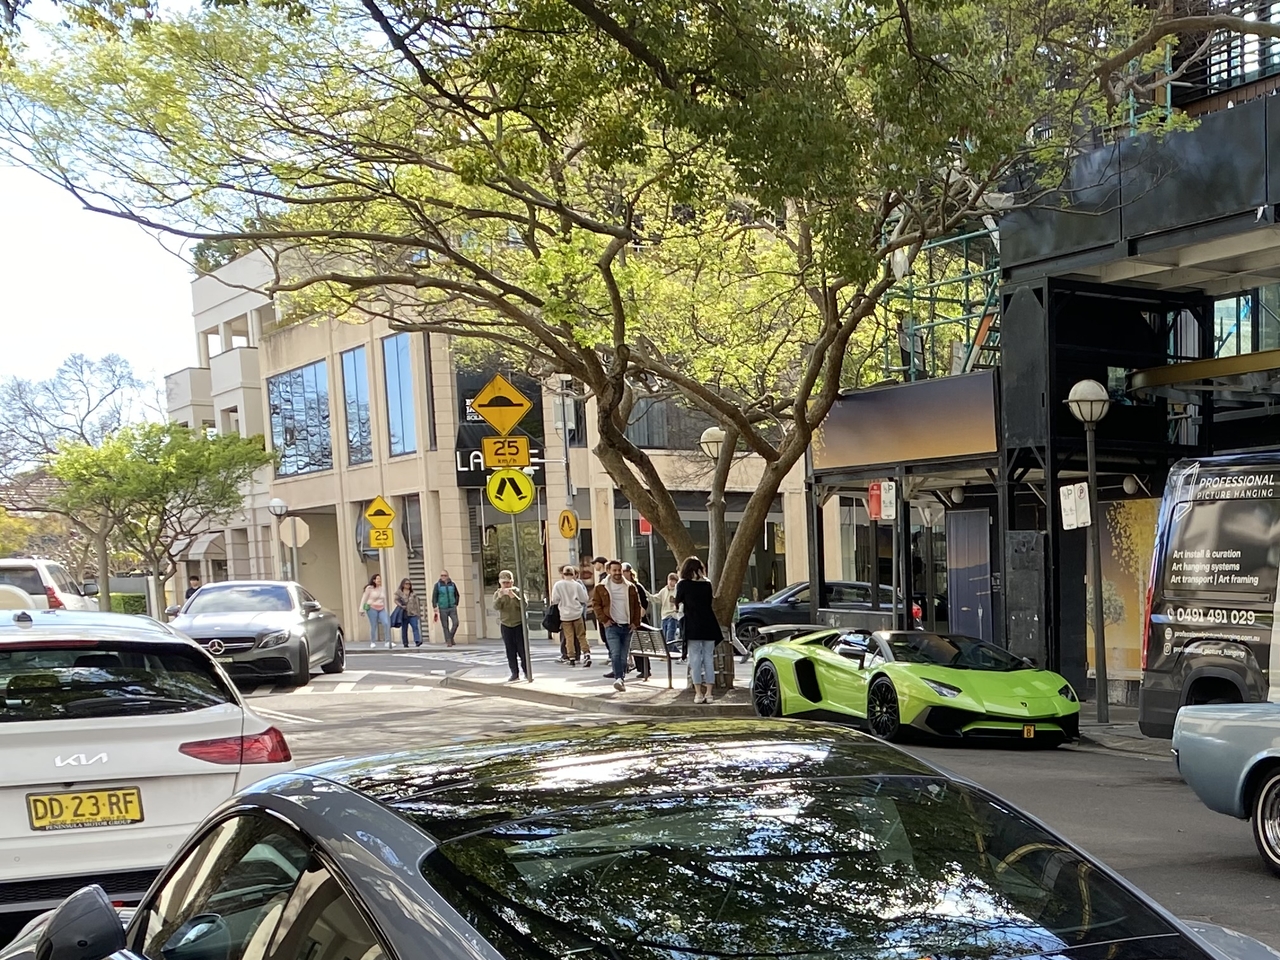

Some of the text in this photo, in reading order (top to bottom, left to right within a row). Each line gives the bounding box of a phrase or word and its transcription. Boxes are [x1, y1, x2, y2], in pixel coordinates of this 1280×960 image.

[493, 440, 520, 457] 25
[1199, 474, 1275, 489] PROFESSIONAL
[1197, 488, 1273, 500] PICTURE HANGING
[375, 530, 389, 541] 25
[1172, 549, 1241, 559] Art install & curation
[1171, 562, 1240, 573] Art hanging systems
[1170, 575, 1181, 584] Art
[1182, 574, 1213, 585] transport
[1218, 575, 1230, 584] Art
[1231, 575, 1259, 586] framing
[1177, 608, 1255, 625] 0491 491 029
